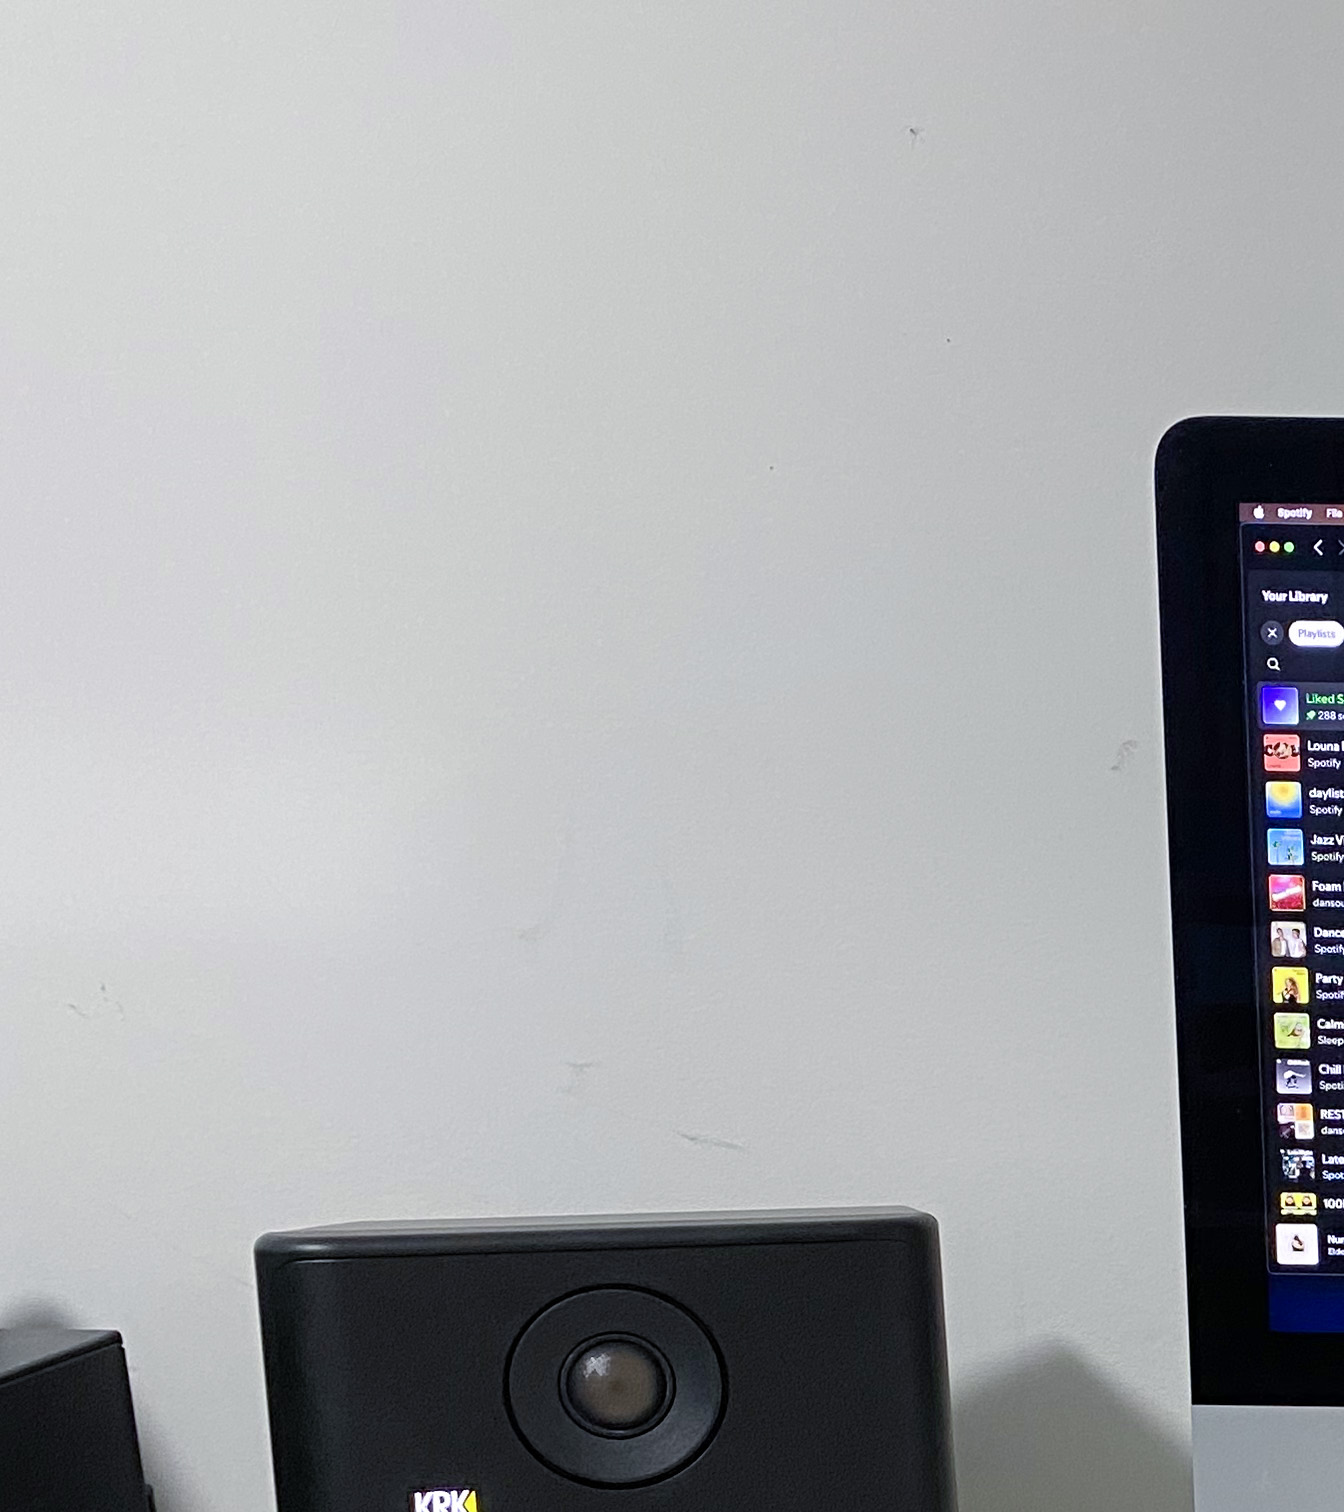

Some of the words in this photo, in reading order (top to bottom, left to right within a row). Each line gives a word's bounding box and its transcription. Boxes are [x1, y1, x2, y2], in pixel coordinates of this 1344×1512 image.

[1278, 508, 1313, 520] Spotify
[1326, 508, 1343, 519] File
[1262, 590, 1287, 601] Your
[1289, 591, 1328, 604] Library
[1298, 629, 1335, 639] Playlists
[1306, 693, 1335, 704] Liked
[1308, 740, 1339, 751] Louna
[1308, 758, 1341, 769] Spotify
[1309, 788, 1344, 800] daylist
[1310, 834, 1334, 847] Jazz
[1312, 881, 1341, 891] Foam
[1316, 973, 1343, 986] Party
[1318, 1036, 1344, 1046] Sleep
[1319, 1064, 1341, 1074] Chill
[1322, 1154, 1344, 1164] Late
